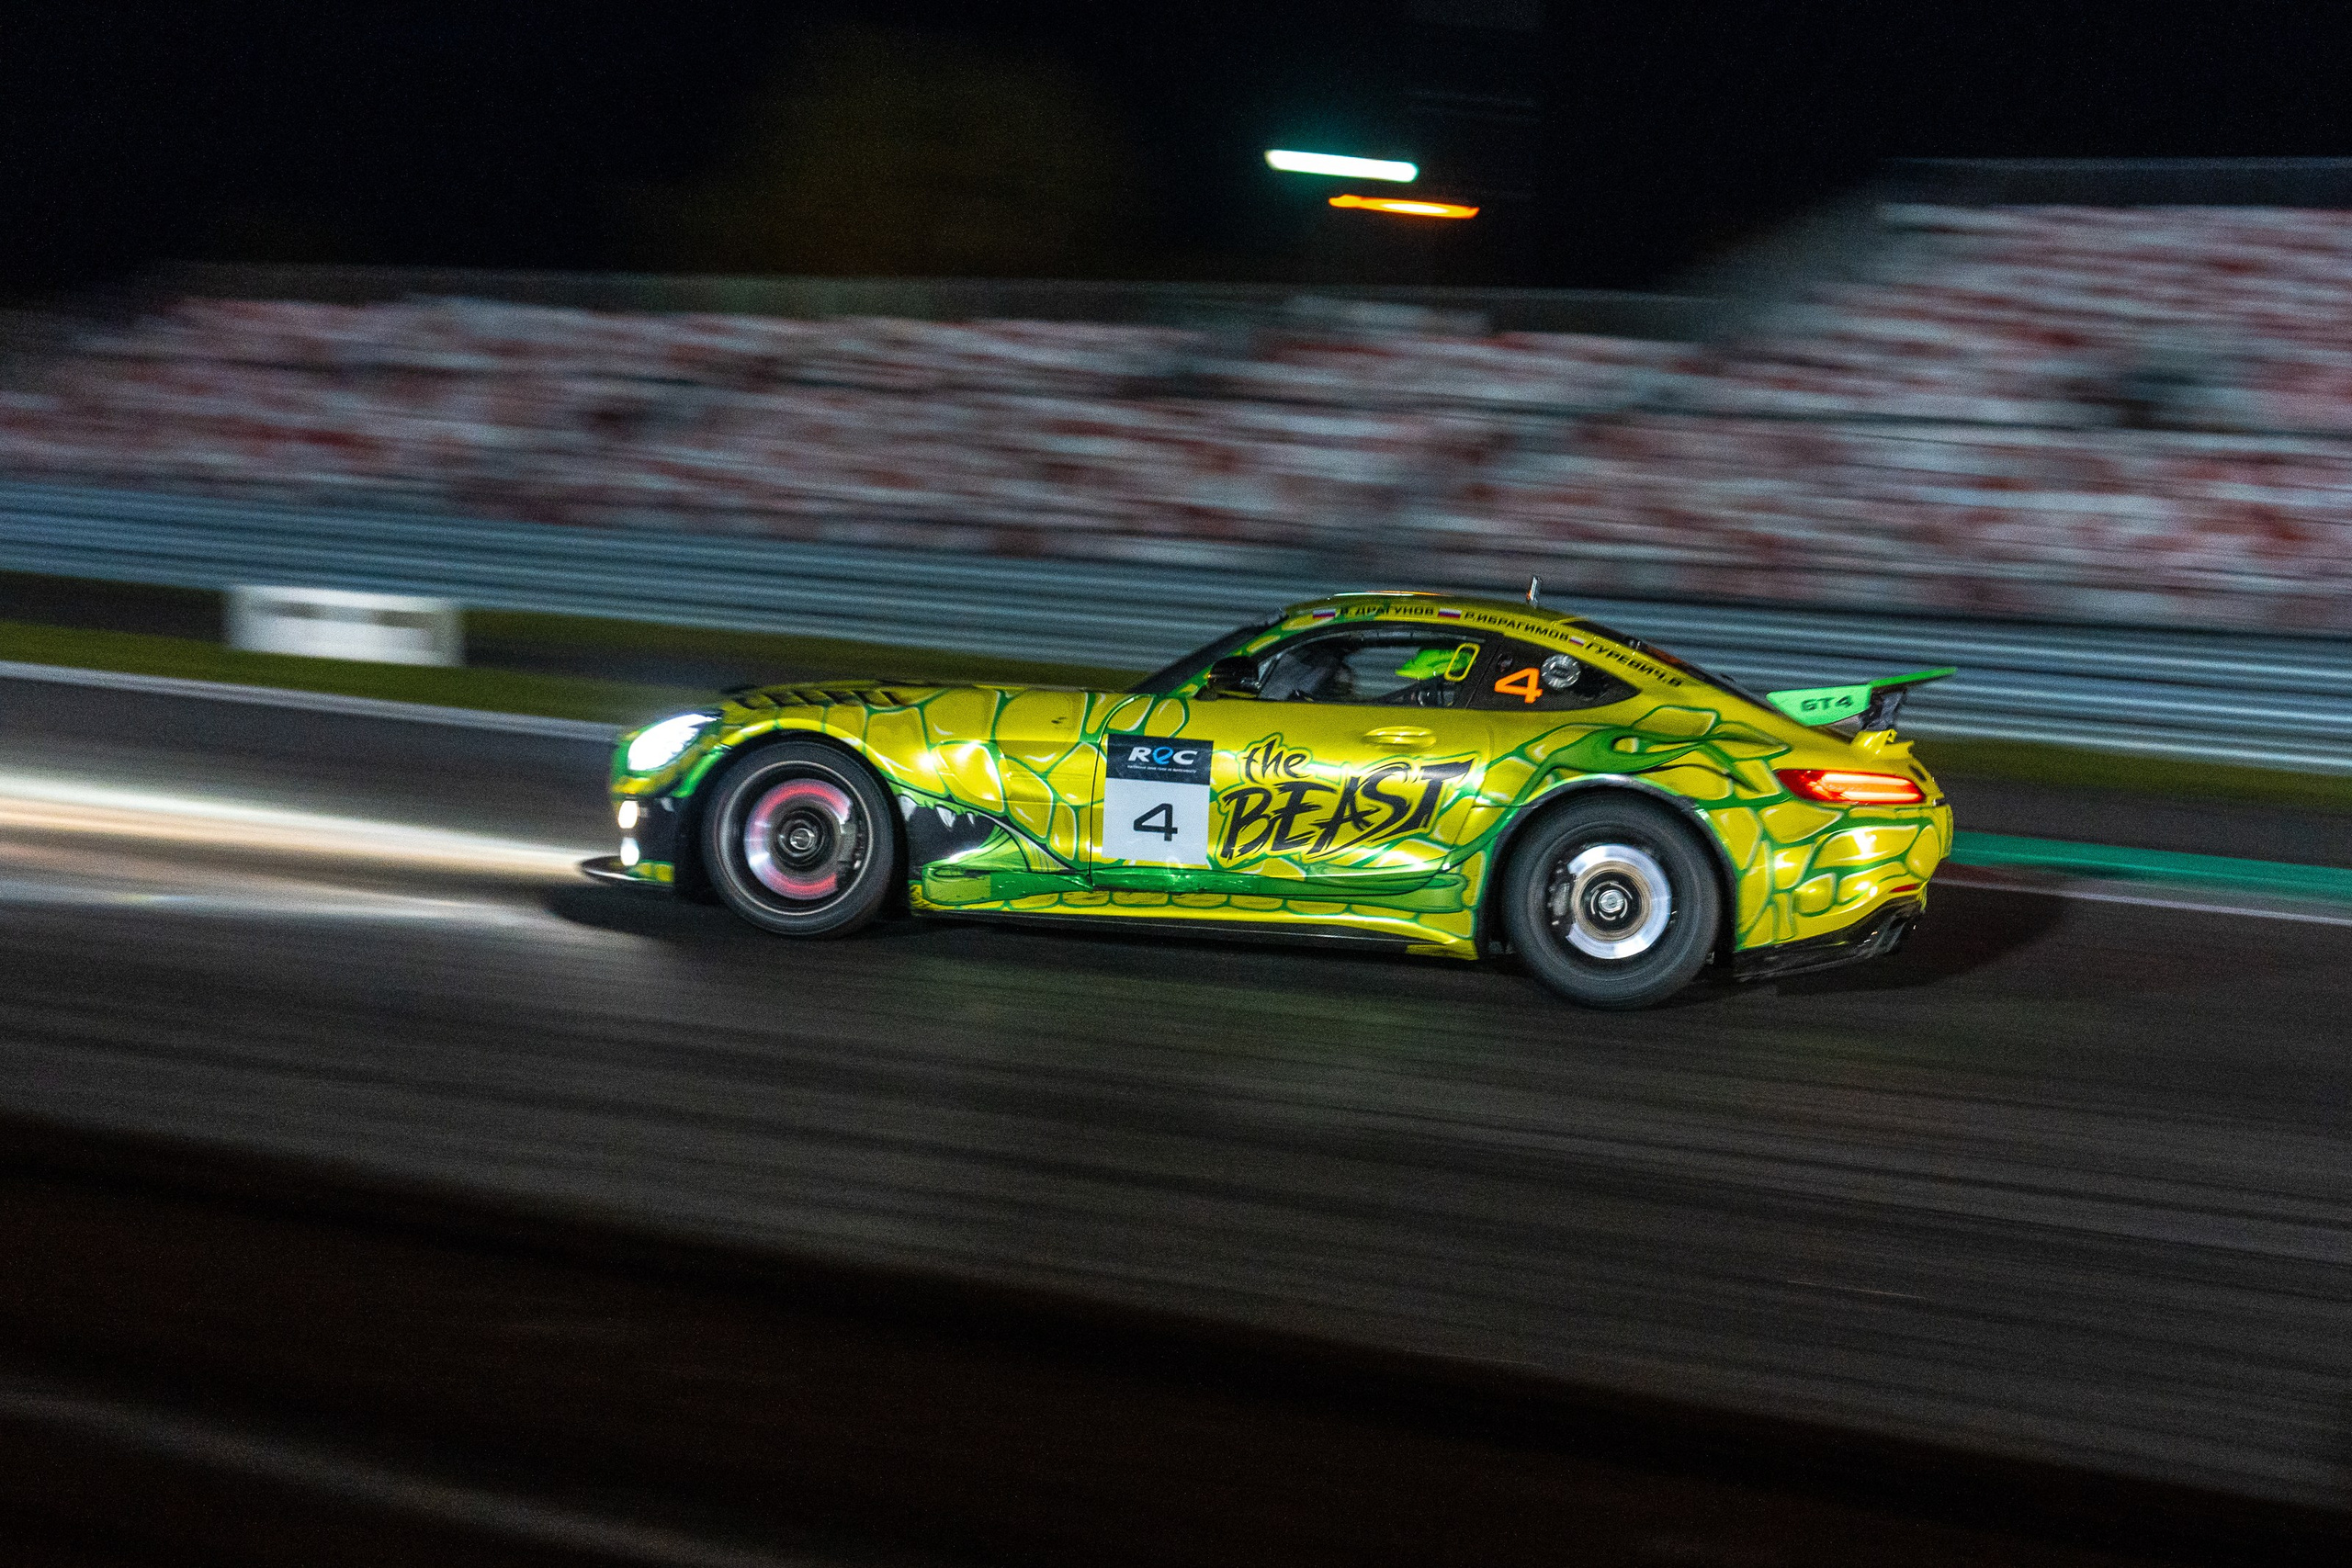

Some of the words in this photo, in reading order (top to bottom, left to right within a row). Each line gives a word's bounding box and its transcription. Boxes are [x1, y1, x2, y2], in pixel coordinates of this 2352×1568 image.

[1355, 605, 1434, 616] ДРАГУНОВ
[1494, 667, 1543, 704] 4
[1801, 694, 1854, 712] GT4
[1242, 738, 1306, 783] the
[1133, 803, 1178, 841] 4
[1220, 758, 1474, 863] BEAST
